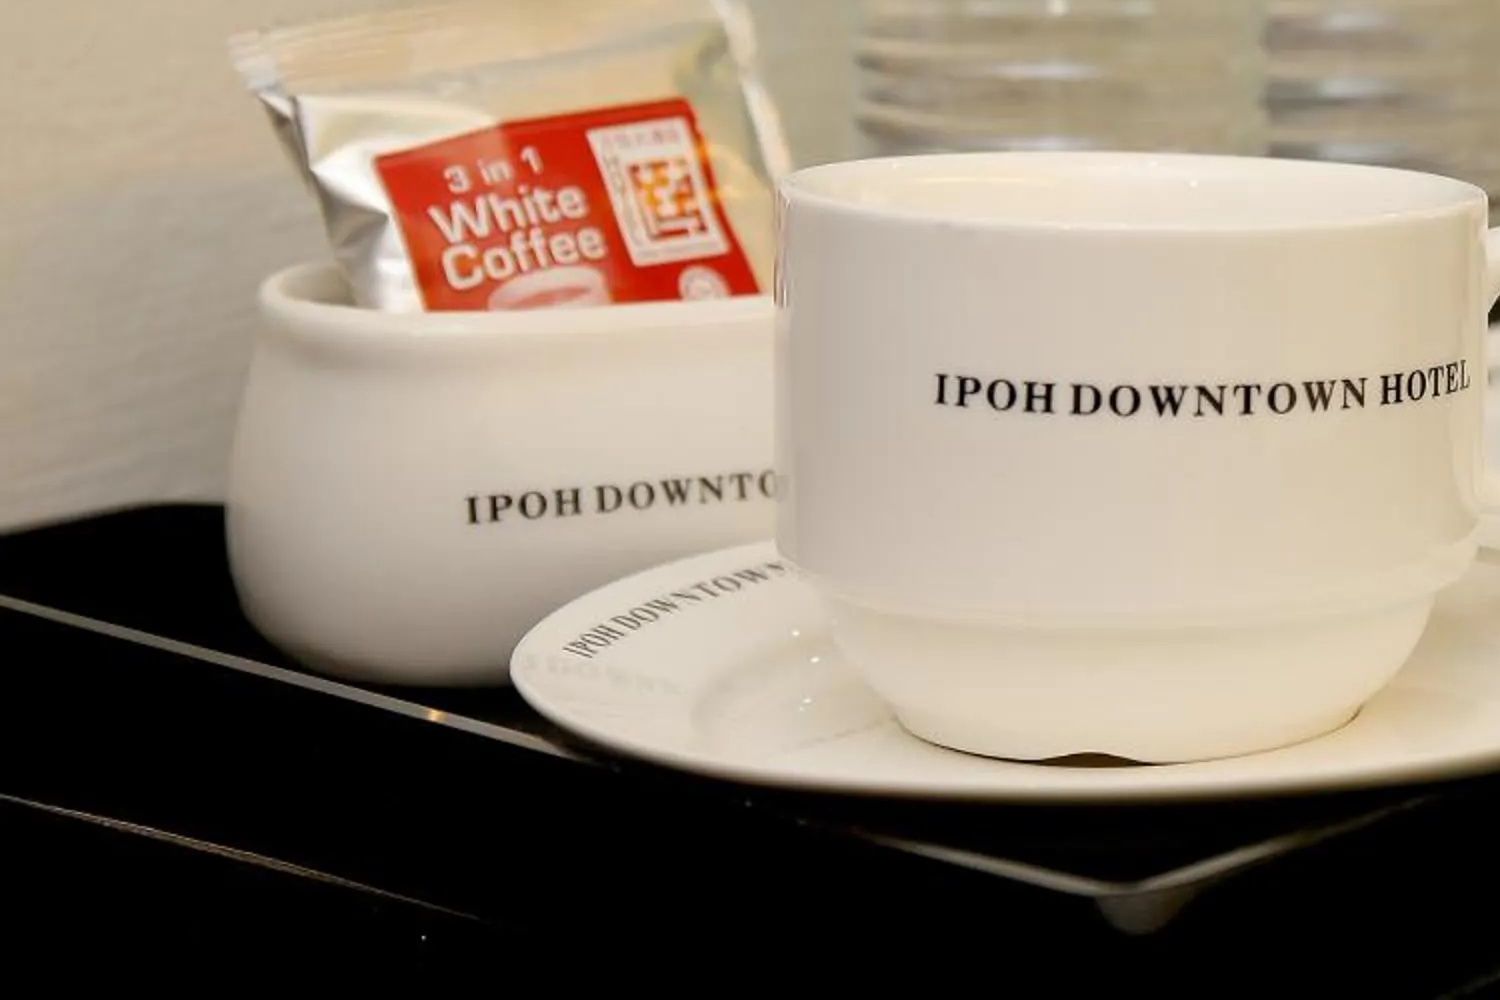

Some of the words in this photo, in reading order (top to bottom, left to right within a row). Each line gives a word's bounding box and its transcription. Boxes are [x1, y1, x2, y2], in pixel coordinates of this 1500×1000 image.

[445, 164, 471, 193] 3
[478, 158, 512, 185] in
[520, 146, 544, 174] 1
[428, 183, 588, 244] White
[442, 226, 607, 291] Coffee
[935, 373, 1057, 414] IPOH
[1069, 377, 1368, 418] DOWNTOWN
[1379, 359, 1471, 406] HOTEL
[464, 486, 583, 526] IPOH
[594, 467, 778, 515] DOWNTO
[562, 624, 626, 659] IPOH
